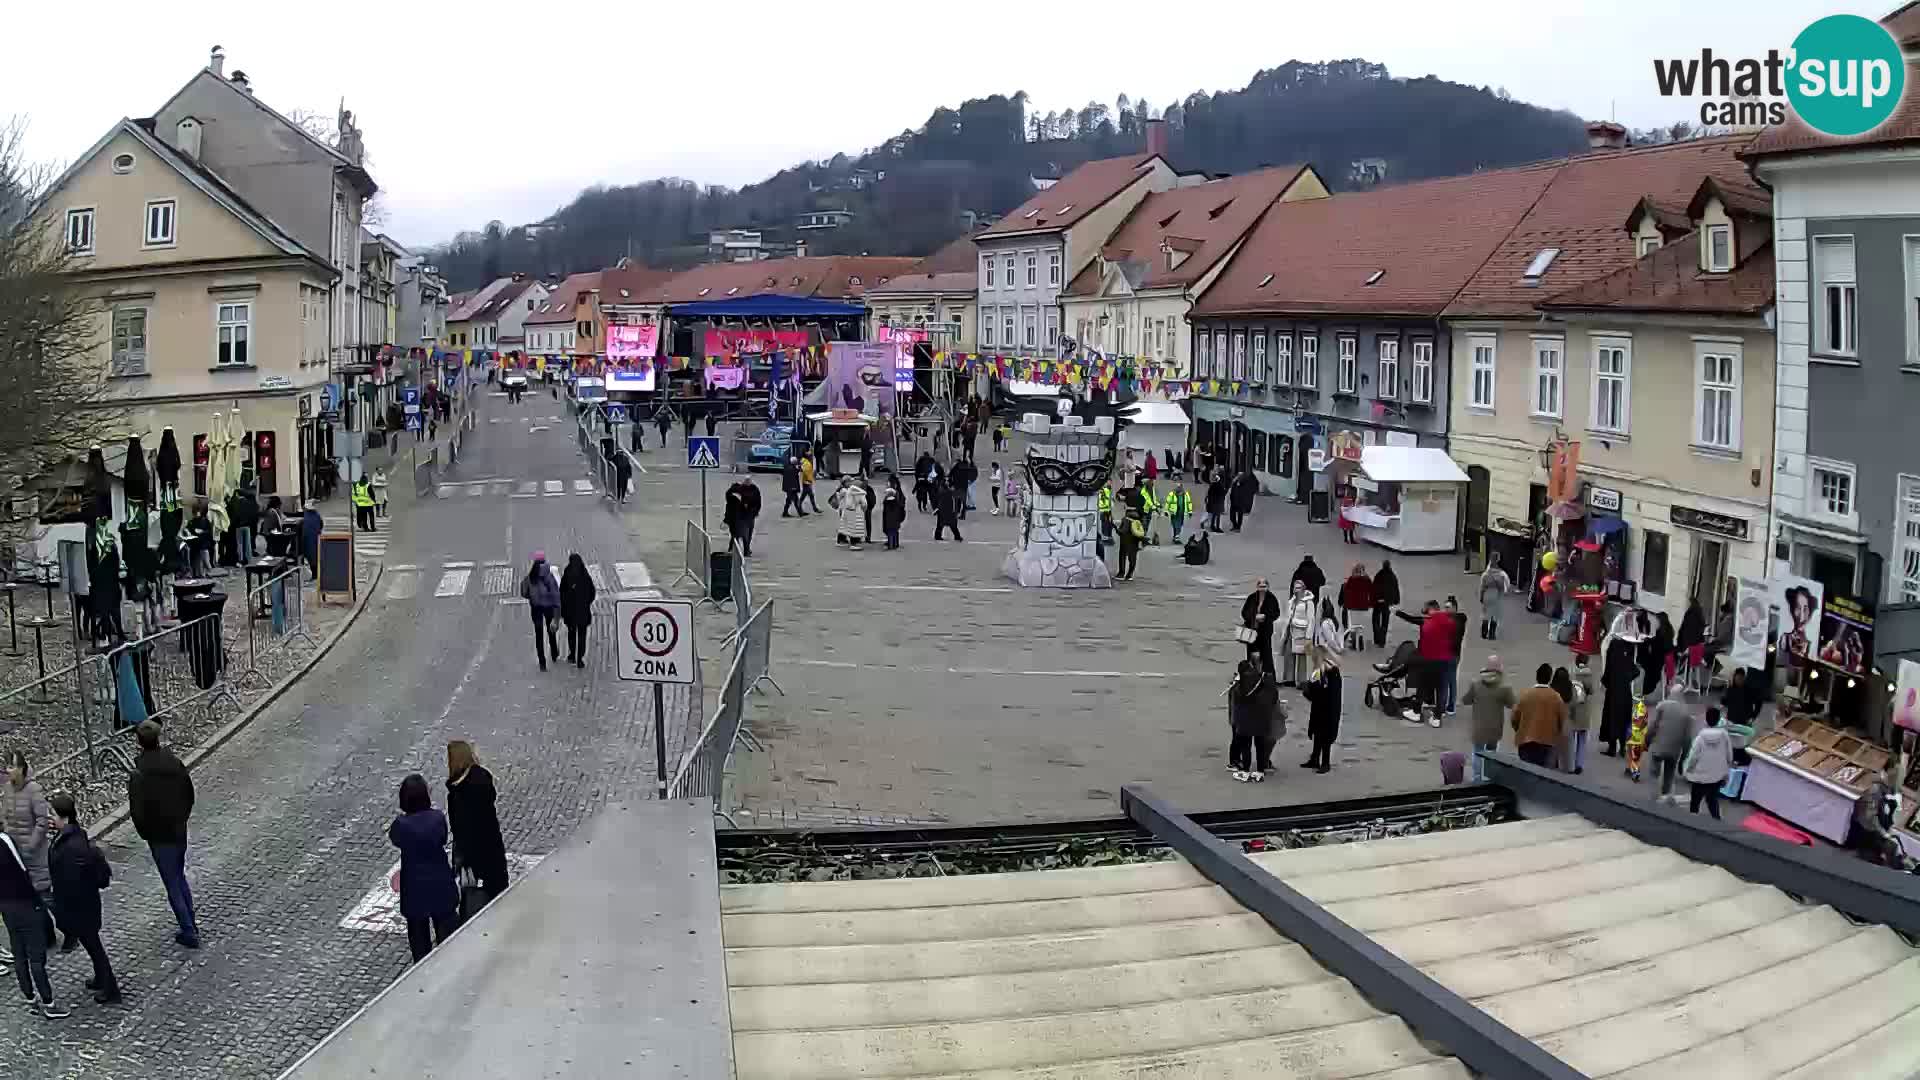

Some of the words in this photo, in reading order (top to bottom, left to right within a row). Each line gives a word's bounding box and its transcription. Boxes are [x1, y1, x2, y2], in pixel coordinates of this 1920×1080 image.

[408, 392, 415, 402] P
[1048, 516, 1087, 546] 200
[643, 622, 667, 643] 30
[633, 660, 678, 677] ZONA
